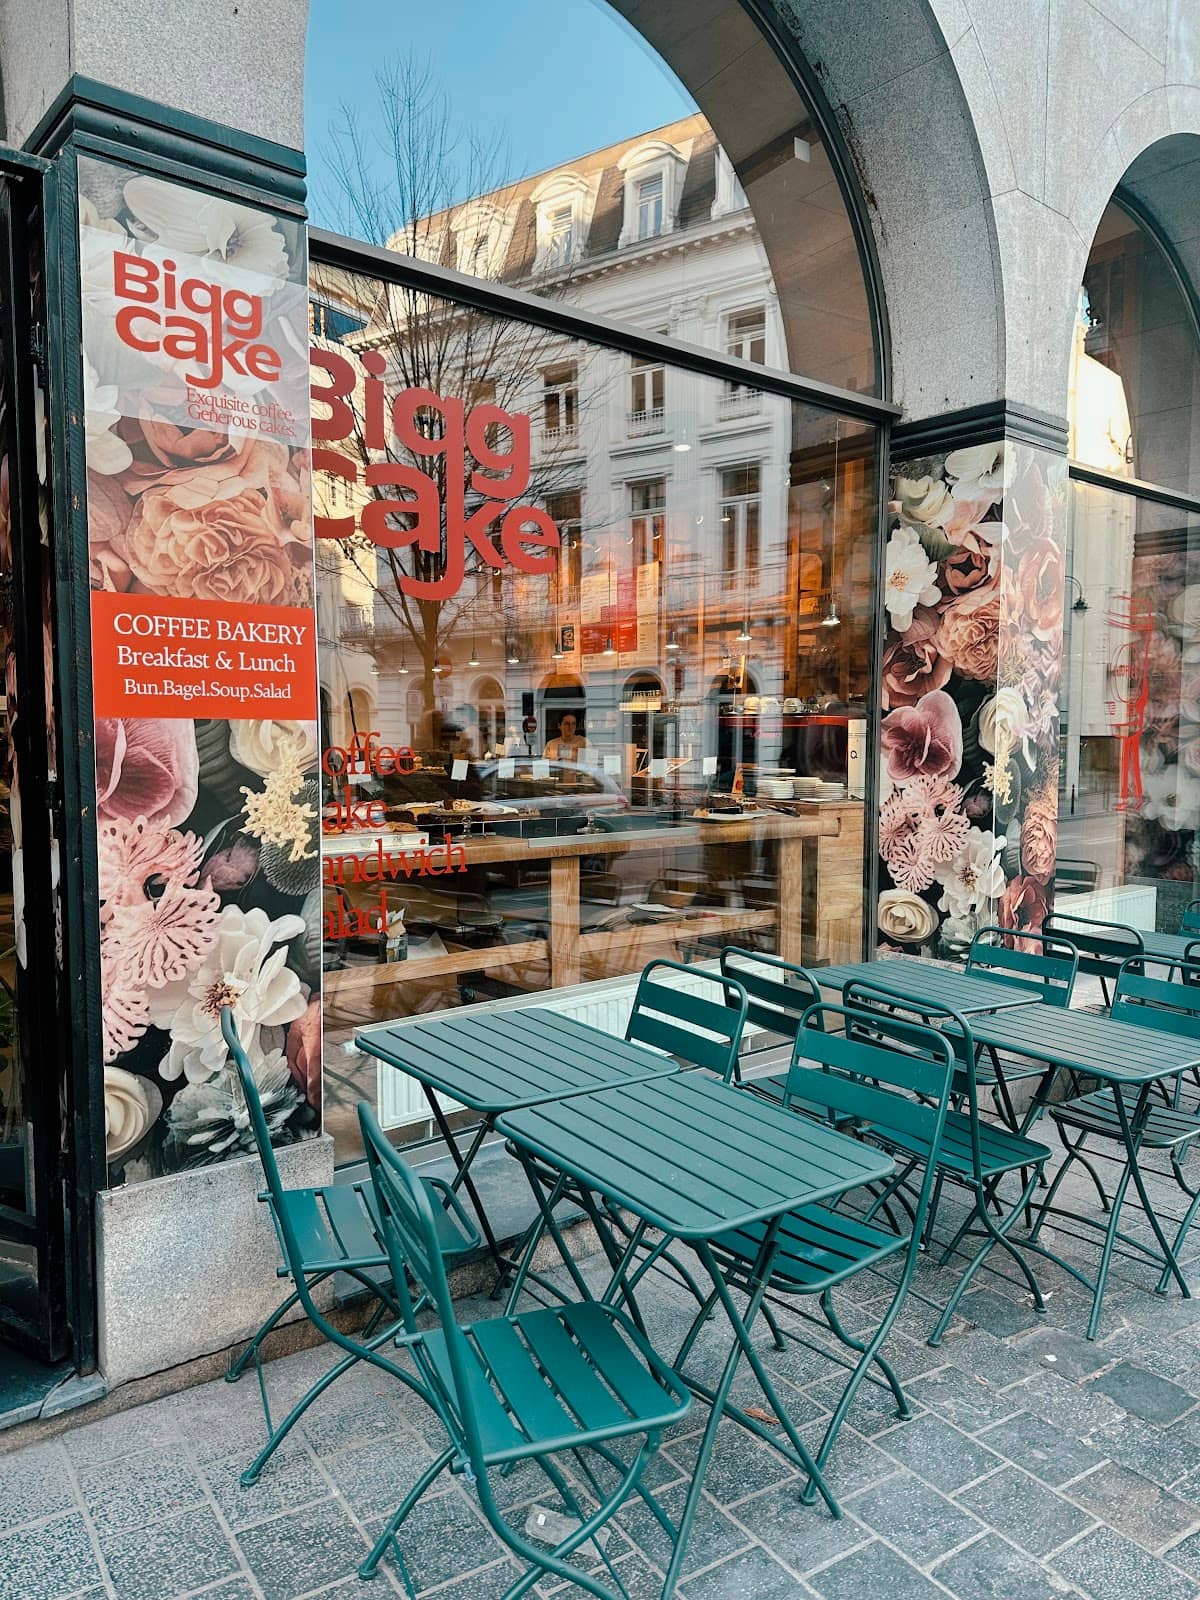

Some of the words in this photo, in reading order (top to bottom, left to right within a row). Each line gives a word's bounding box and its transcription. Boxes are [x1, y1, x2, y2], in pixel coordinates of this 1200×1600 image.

[113, 250, 263, 340] Bigg
[186, 387, 249, 413] Exquisite
[252, 402, 296, 423] coffee,
[188, 403, 257, 430] Generous
[113, 612, 211, 640] COFFEE
[216, 619, 307, 646] BAKERY
[117, 645, 210, 670] Breakfast
[215, 650, 233, 670] &
[239, 651, 296, 673] Lunch
[124, 678, 292, 702] Bun.Bagel.Soup.Salad
[322, 730, 416, 777] offee
[322, 785, 387, 831] ake
[322, 833, 468, 886] andwich
[322, 889, 388, 940] alad
